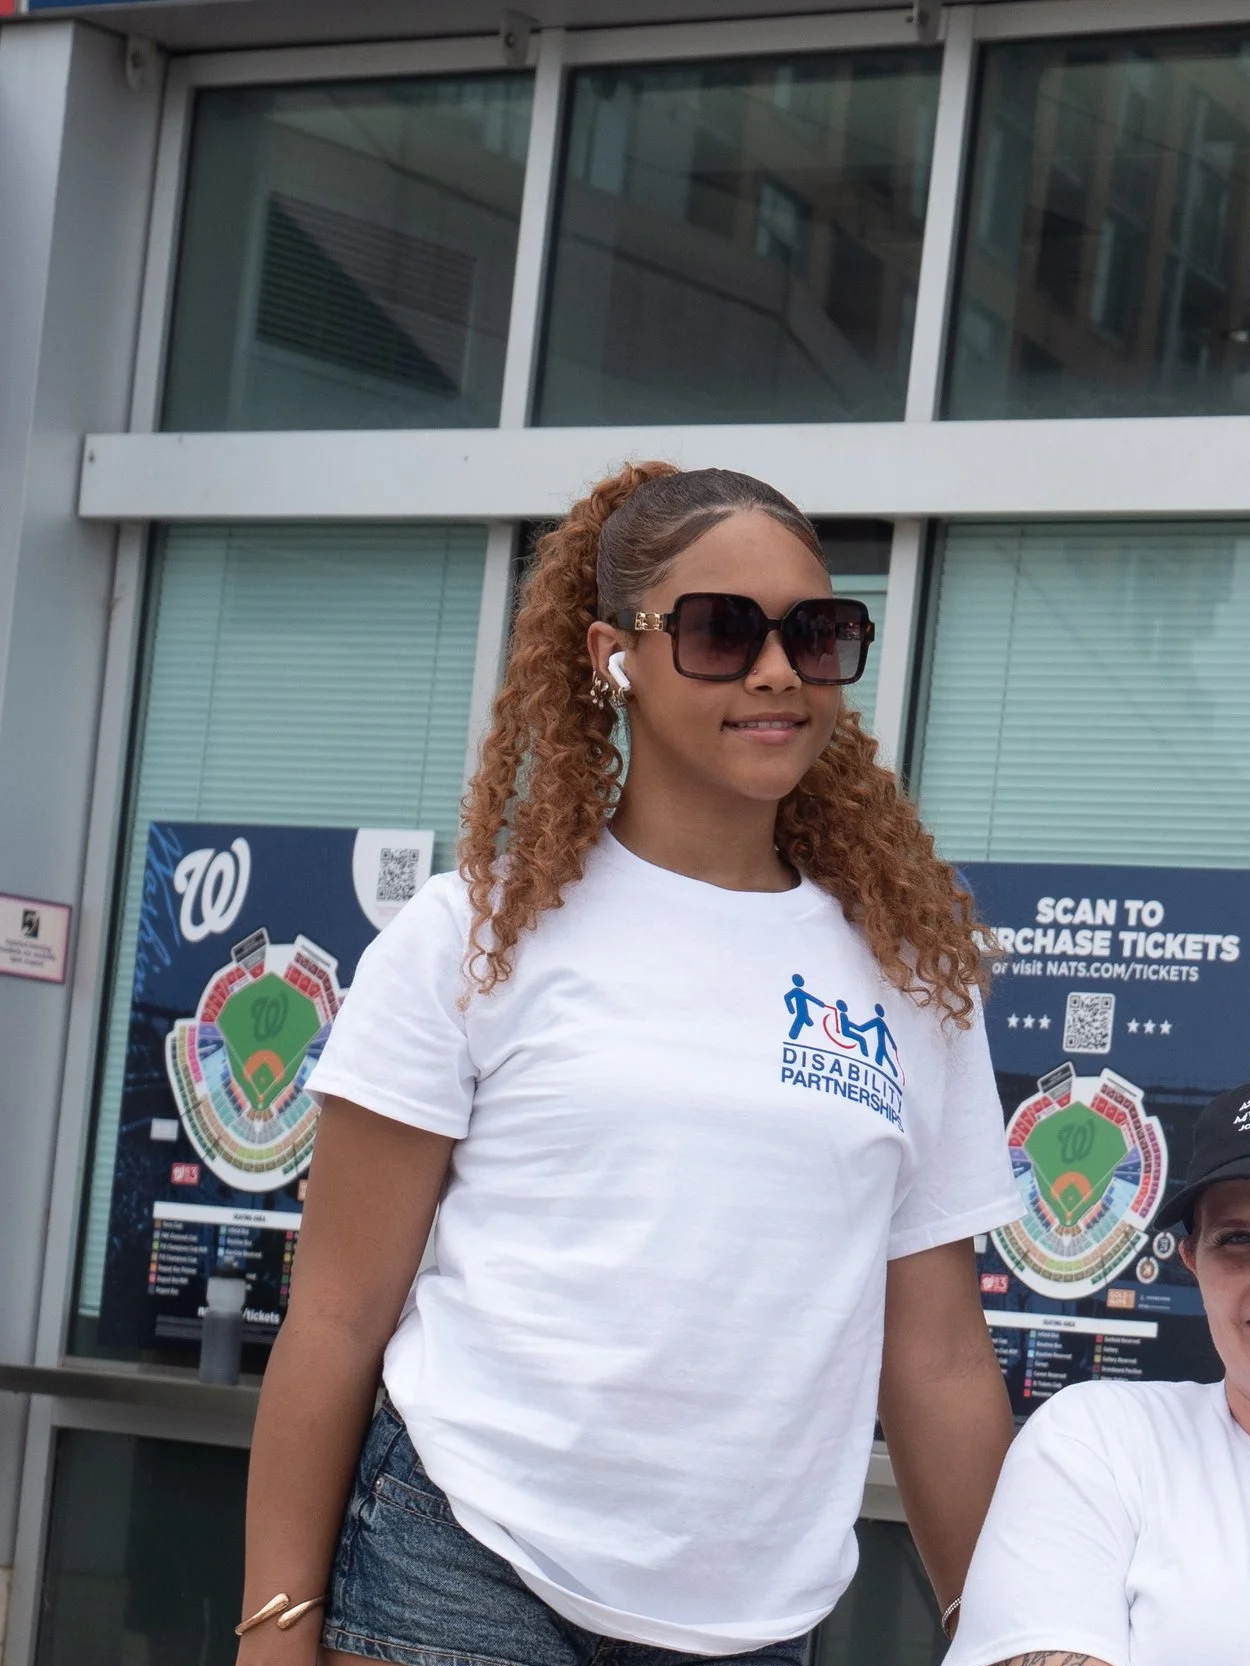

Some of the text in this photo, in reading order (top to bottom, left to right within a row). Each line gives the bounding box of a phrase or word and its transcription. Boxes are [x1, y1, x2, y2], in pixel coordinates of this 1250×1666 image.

[1036, 896, 1165, 928] SCAN TO
[971, 926, 1241, 962] URCHASE TICKETS
[992, 959, 1199, 982] or visit NATS.COM/TICKETS
[782, 1047, 902, 1114] DISABILITY
[781, 1066, 905, 1133] PARTNERSHIPS
